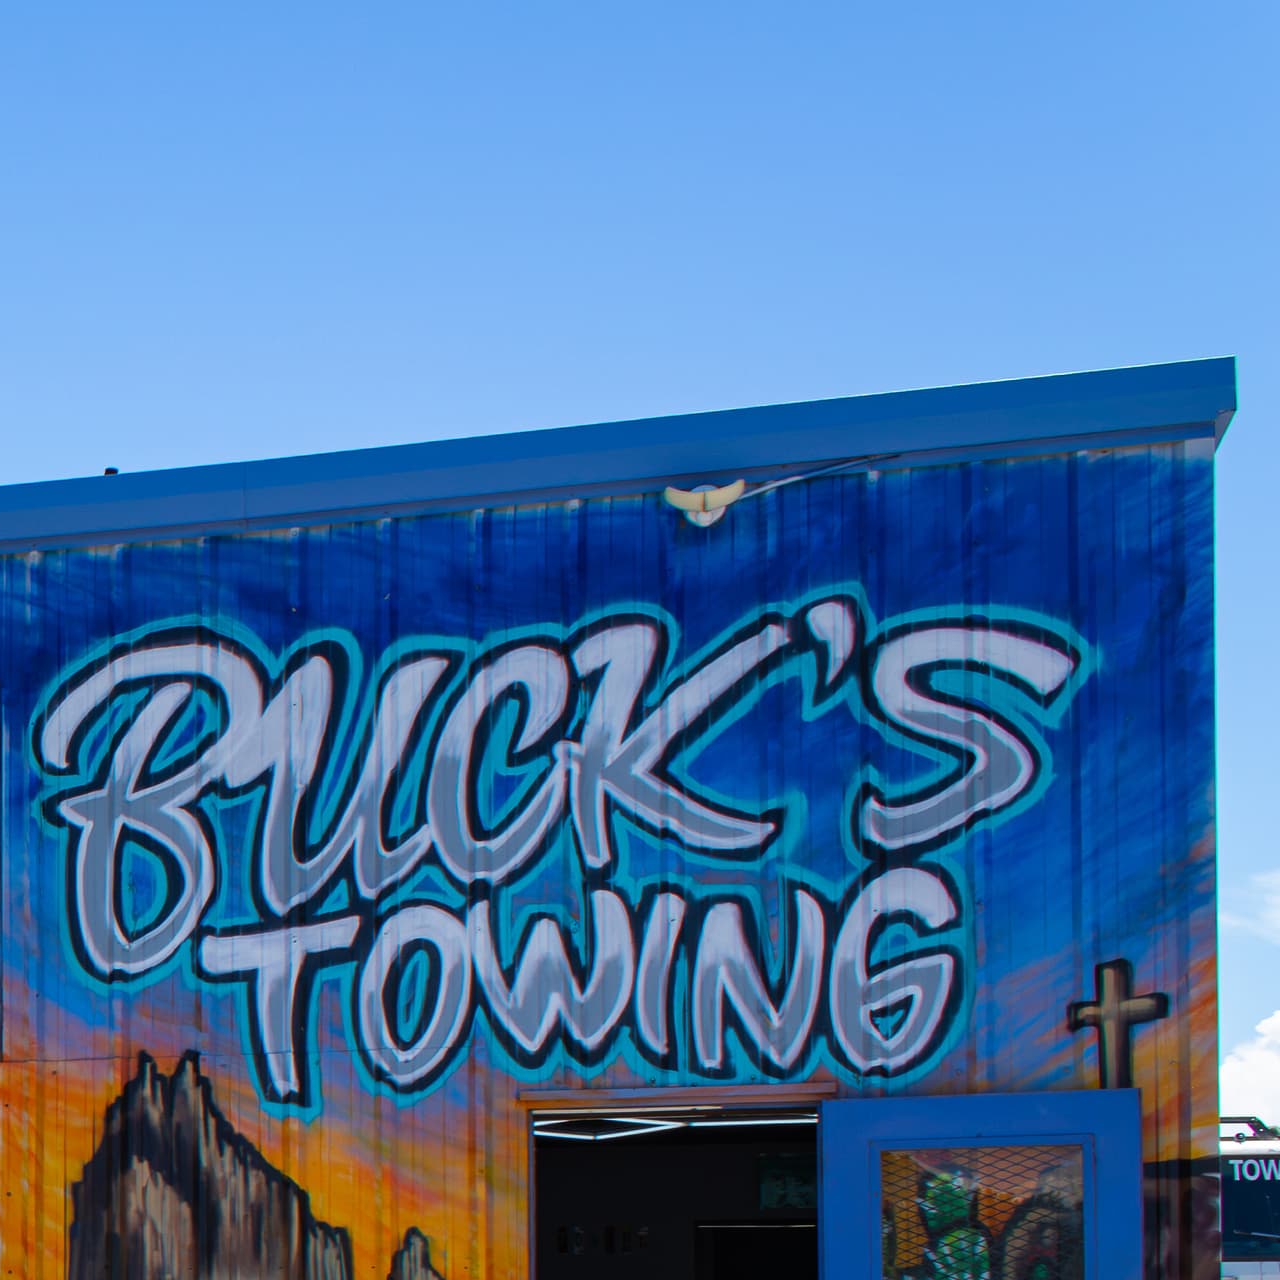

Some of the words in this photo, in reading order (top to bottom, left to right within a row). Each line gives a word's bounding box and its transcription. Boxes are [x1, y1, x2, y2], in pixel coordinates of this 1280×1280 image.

[30, 588, 1088, 984] BUCK'S
[198, 860, 966, 1108] TOWING
[1228, 1158, 1280, 1182] TOW
